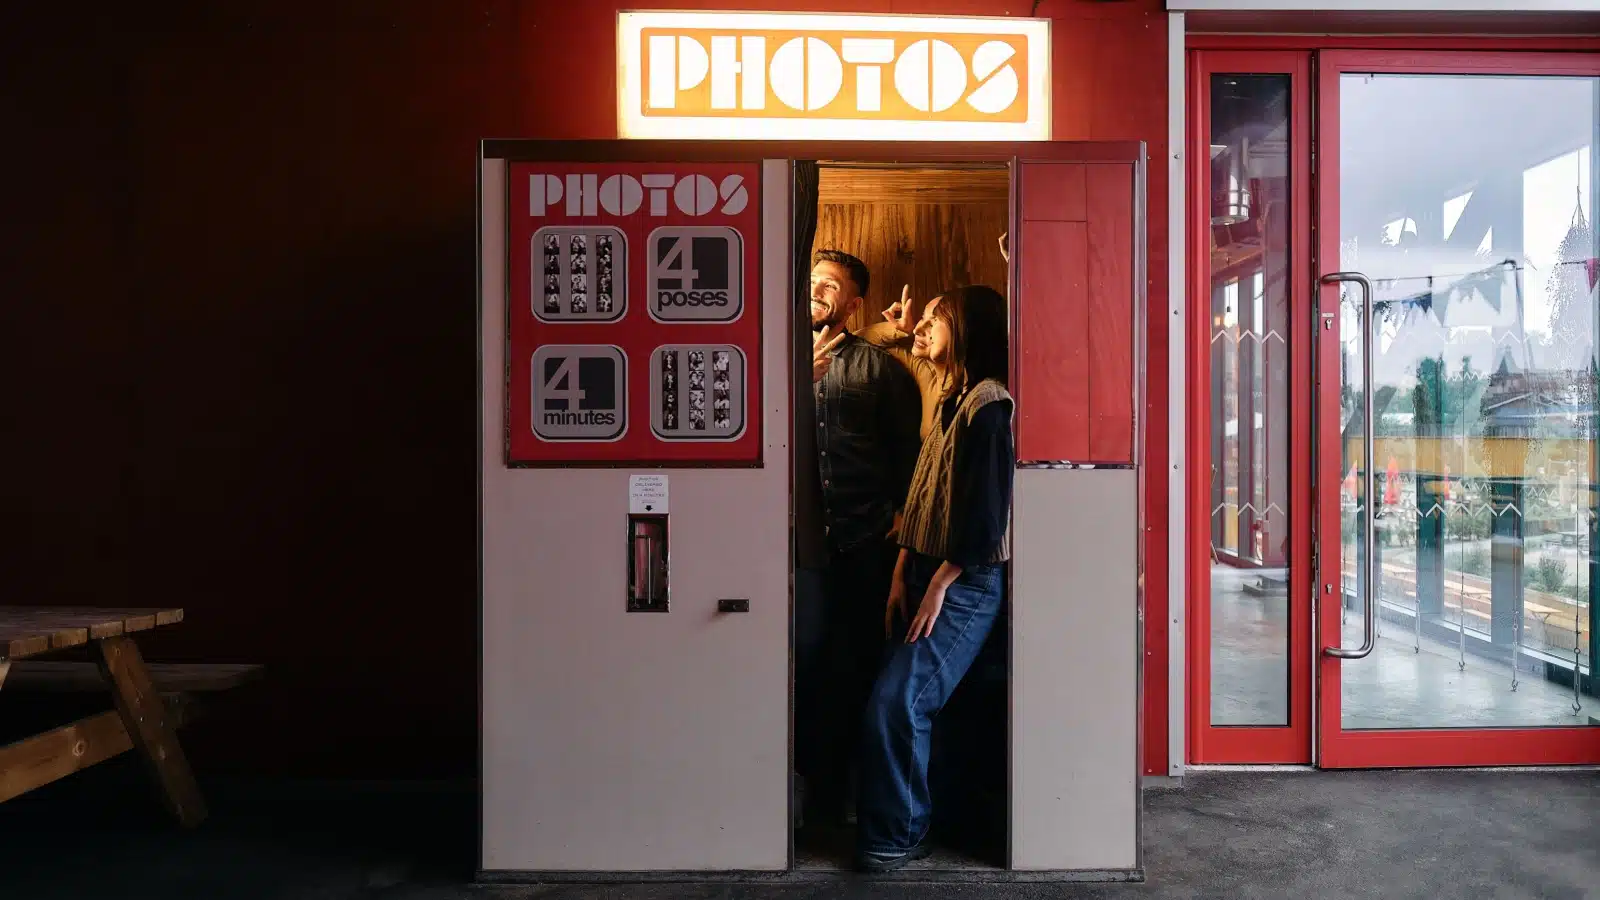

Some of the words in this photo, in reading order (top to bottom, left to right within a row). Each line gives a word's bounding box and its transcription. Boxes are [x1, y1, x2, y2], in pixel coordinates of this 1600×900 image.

[649, 35, 1019, 114] PHOTOS
[530, 174, 749, 217] PHOTOS
[658, 237, 698, 289] 4
[658, 290, 729, 311] poses
[544, 357, 585, 409] 4
[544, 410, 615, 425] minutes
